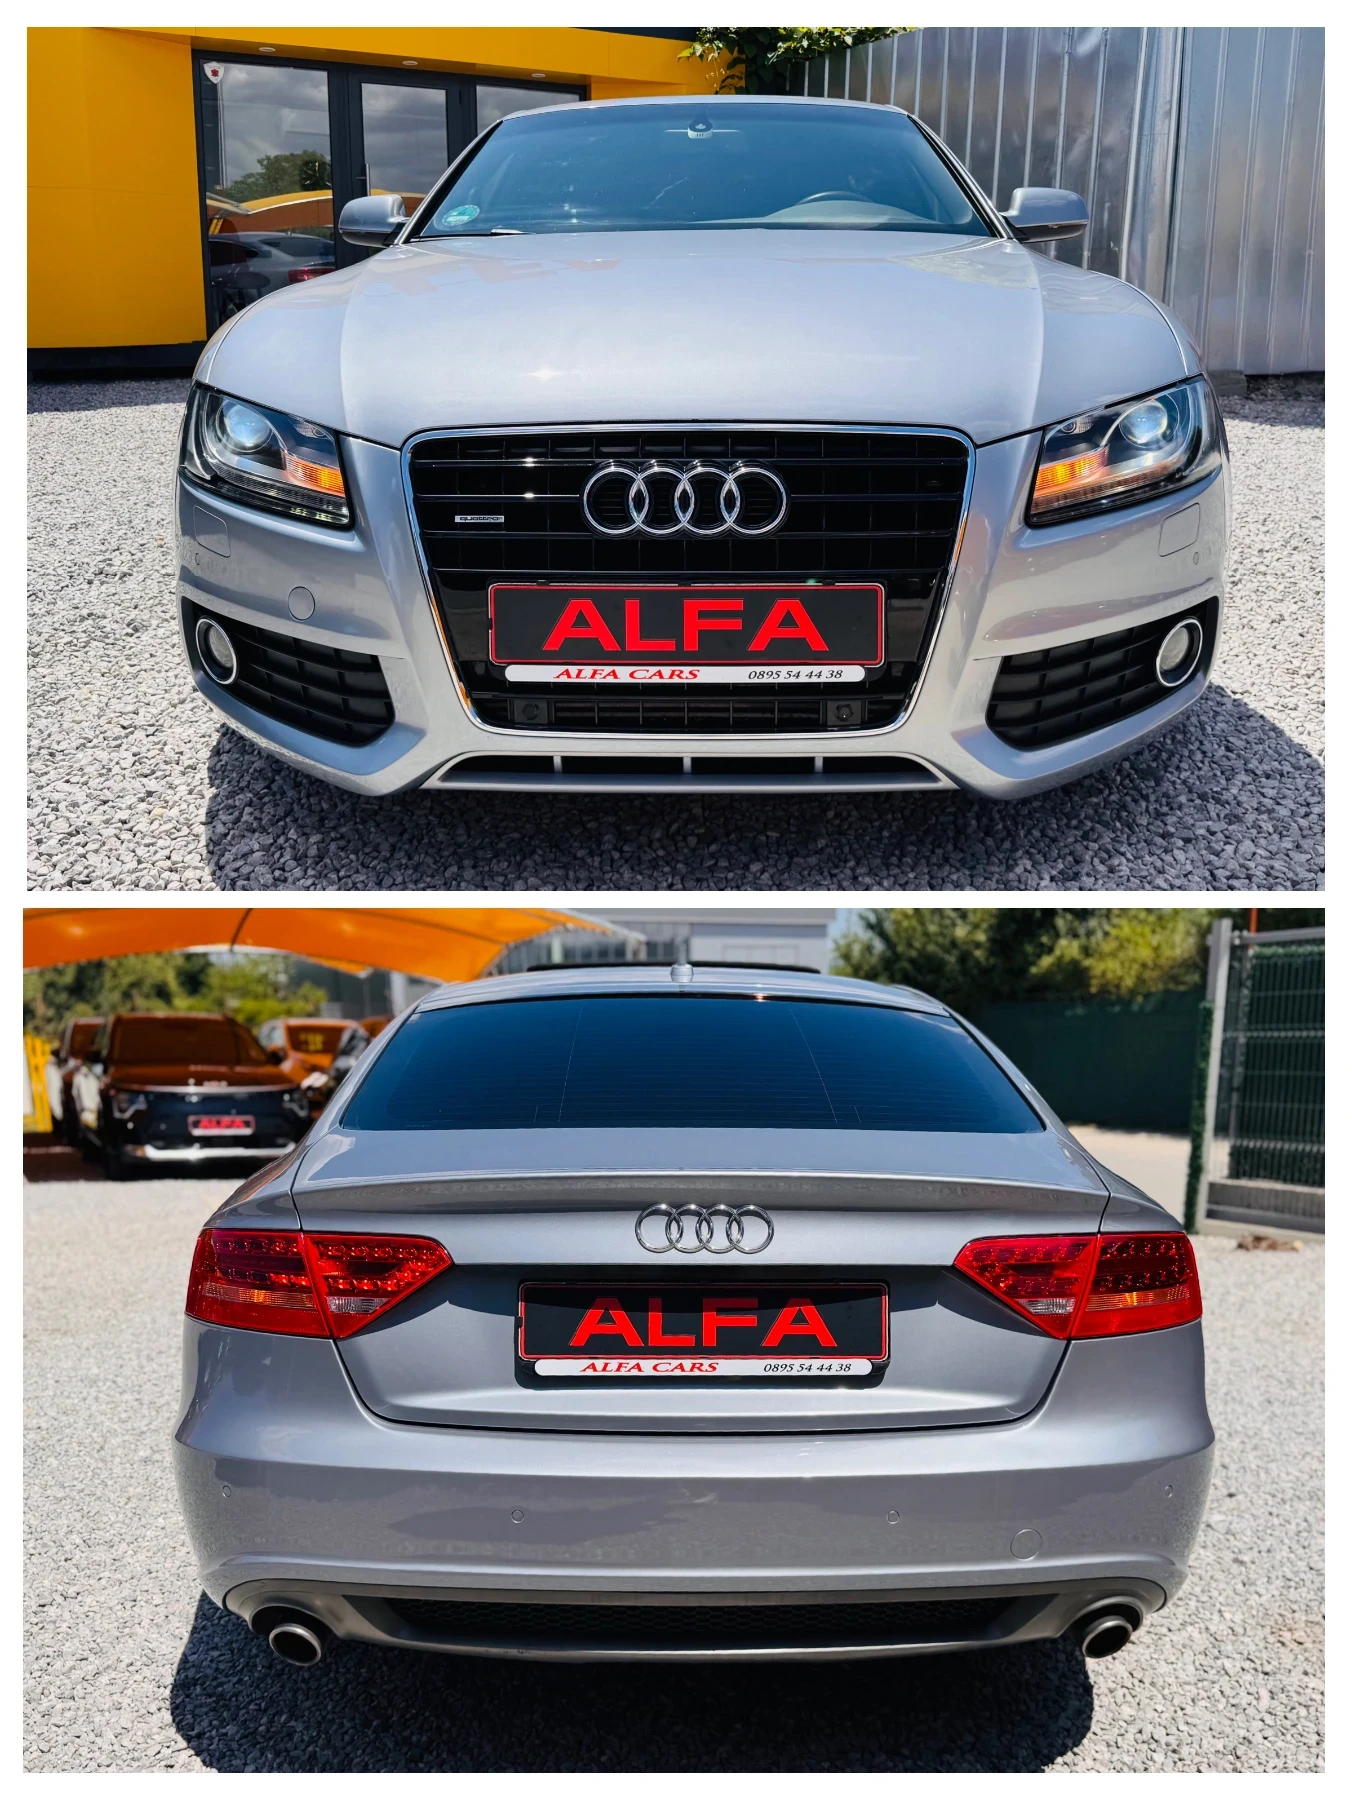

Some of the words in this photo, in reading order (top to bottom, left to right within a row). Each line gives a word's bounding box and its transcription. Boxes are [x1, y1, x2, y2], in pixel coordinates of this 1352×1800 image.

[541, 598, 830, 652] ALFA
[552, 668, 621, 680] ALFA
[628, 668, 700, 680] CARS
[748, 670, 782, 680] 0895
[783, 670, 801, 680] 54
[805, 670, 823, 680] 44
[825, 669, 843, 679] 38
[198, 1117, 246, 1129] ALFA
[568, 1297, 838, 1347] ALFA
[580, 1362, 645, 1373] ALFA
[651, 1362, 719, 1373] CARS
[763, 1363, 795, 1373] 0895
[796, 1363, 813, 1373] 54
[816, 1363, 833, 1372] 44
[835, 1363, 852, 1372] 38
